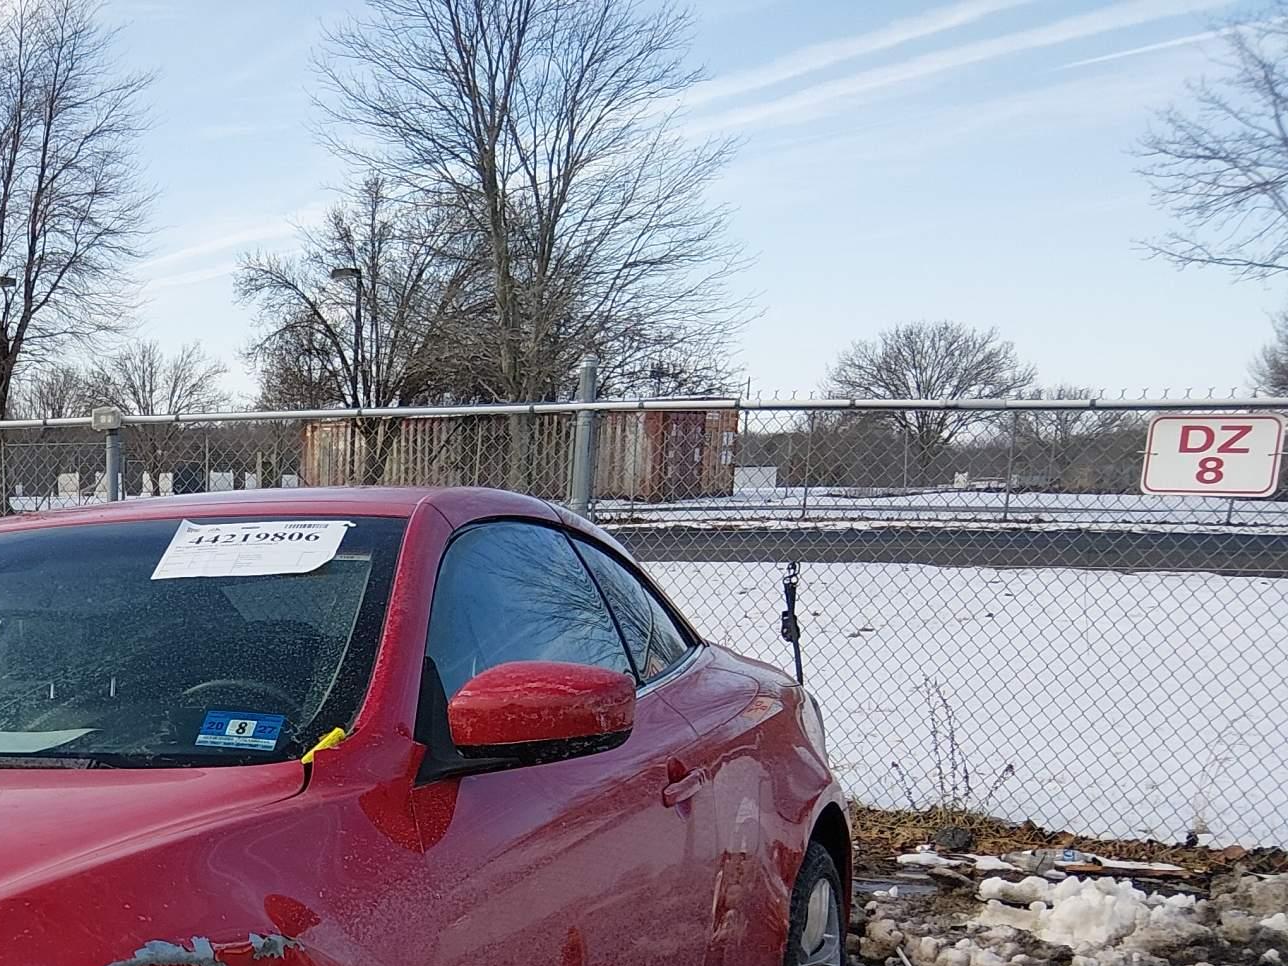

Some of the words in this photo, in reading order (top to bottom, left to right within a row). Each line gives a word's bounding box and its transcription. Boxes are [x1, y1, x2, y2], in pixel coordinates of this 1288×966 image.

[1178, 425, 1253, 454] DZ
[1195, 456, 1224, 485] 8
[188, 531, 321, 546] 44219806
[206, 721, 225, 731] 20
[235, 721, 248, 735] 8
